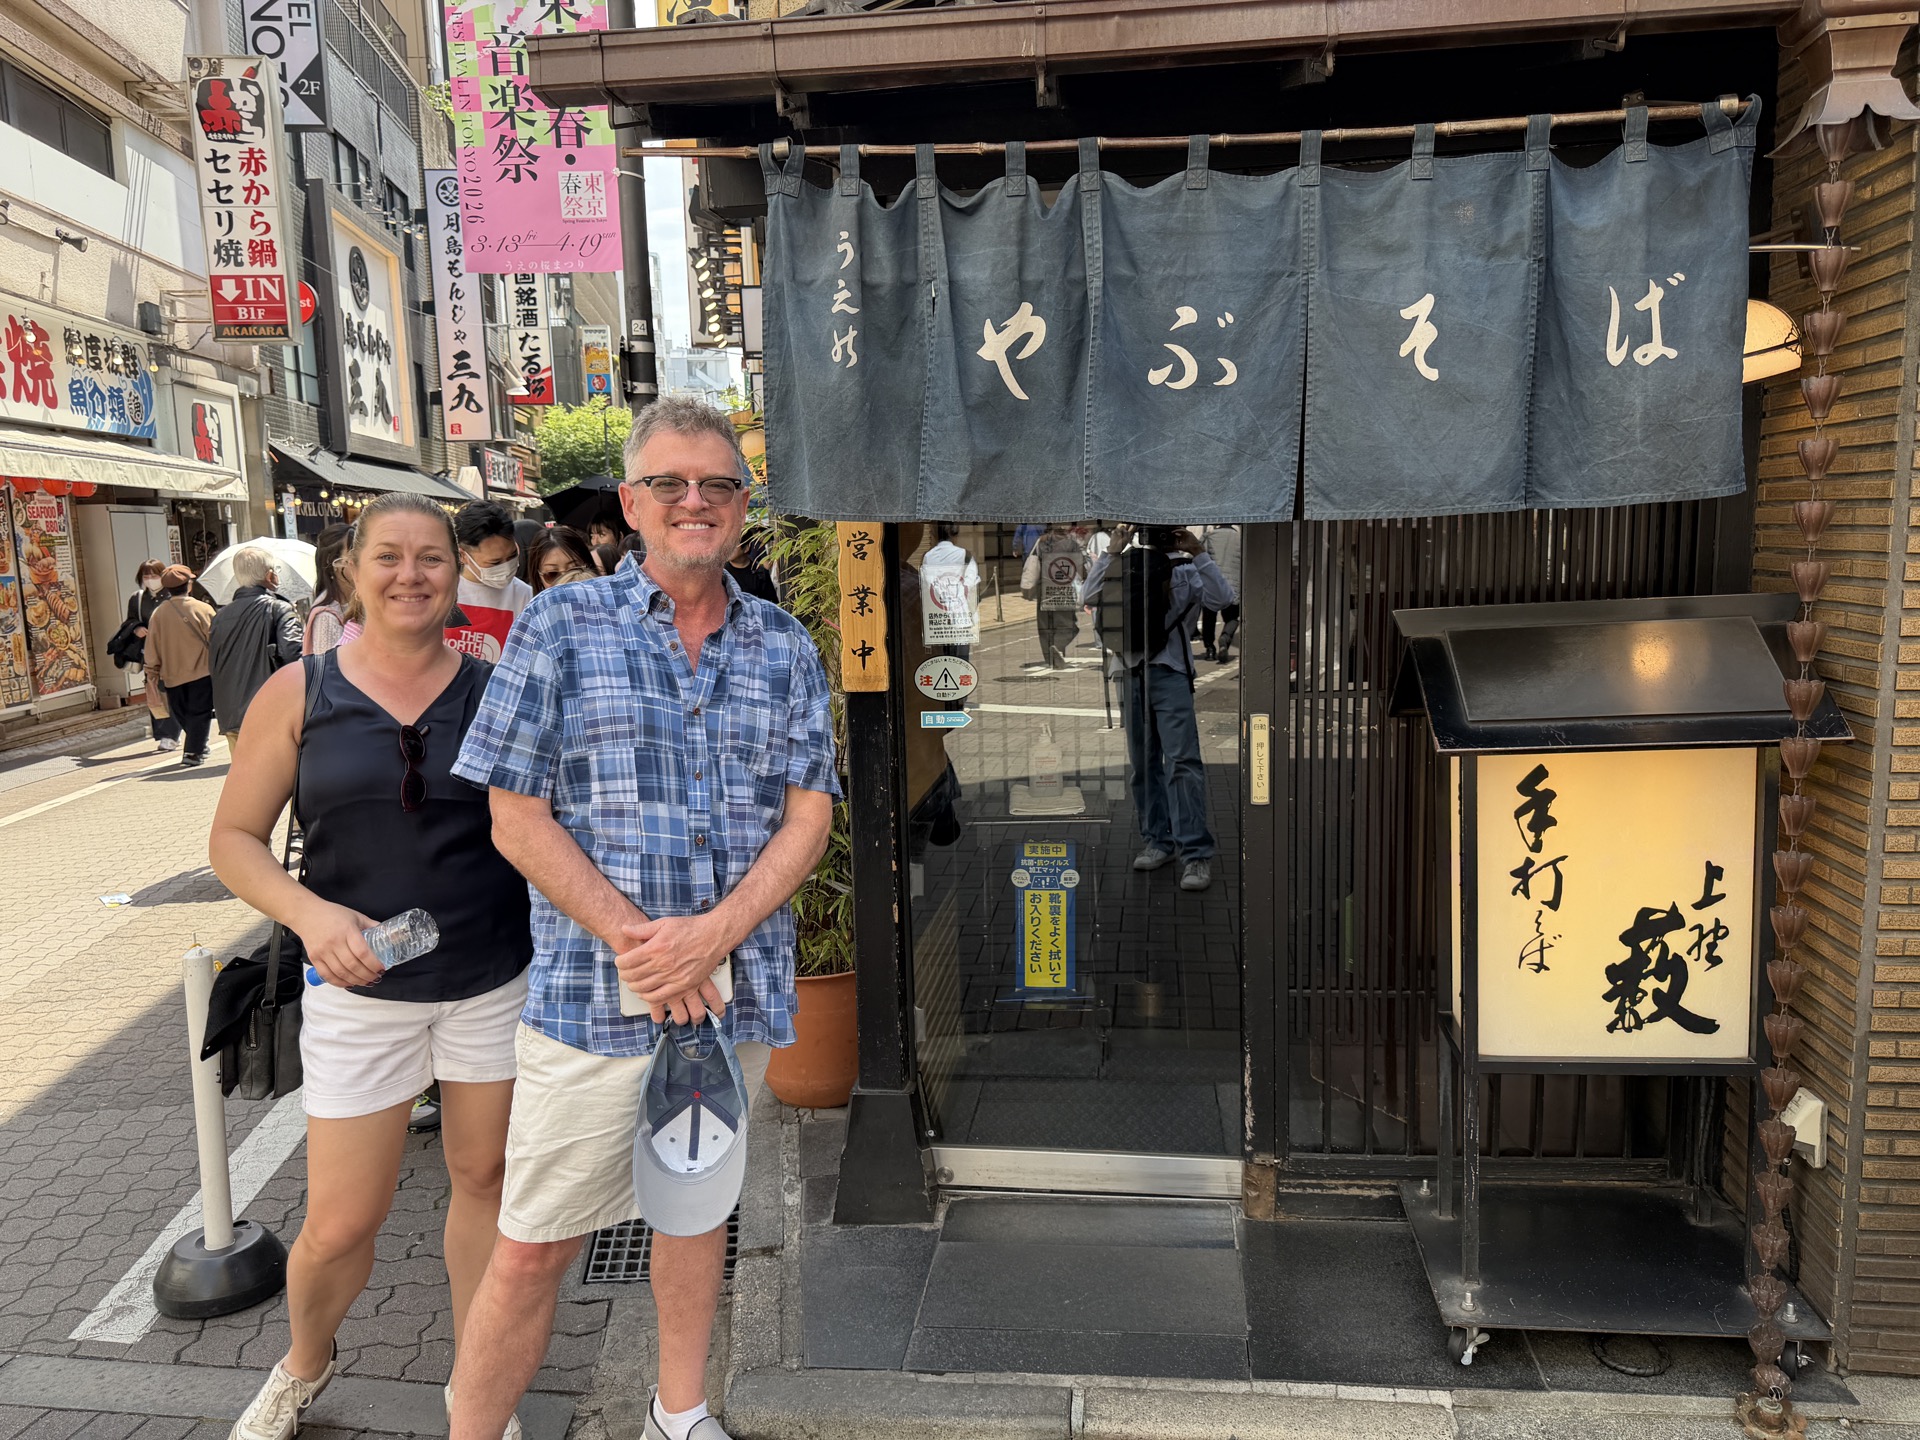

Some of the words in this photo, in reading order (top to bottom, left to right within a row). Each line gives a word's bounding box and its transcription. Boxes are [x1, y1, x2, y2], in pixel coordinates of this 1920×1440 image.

[452, 11, 470, 89] FESTIVAL
[298, 79, 321, 95] 2F
[459, 94, 472, 111] IN
[483, 25, 541, 184] 音楽祭
[461, 115, 477, 173] TOKYO
[463, 176, 485, 224] 2026
[561, 173, 583, 217] 春祭
[582, 173, 603, 217] 東京
[205, 148, 244, 268] セセリ焼
[238, 147, 278, 268] 赤から鍋
[505, 260, 585, 272] うえの桜まつり
[242, 277, 281, 301] IN
[237, 307, 266, 320] B1F
[222, 325, 284, 337] AKAKARA
[633, 322, 646, 333] 24
[27, 505, 56, 521] SEAFOOD
[45, 520, 59, 533] BBQ
[846, 530, 877, 671] 営業中
[460, 630, 483, 643] THE
[925, 715, 945, 724] 自動
[1029, 845, 1062, 855] 実施中
[1029, 866, 1061, 874] 加工マット
[1029, 893, 1042, 973] お入りください
[1048, 893, 1061, 984] 靴裏をよく拭いて
